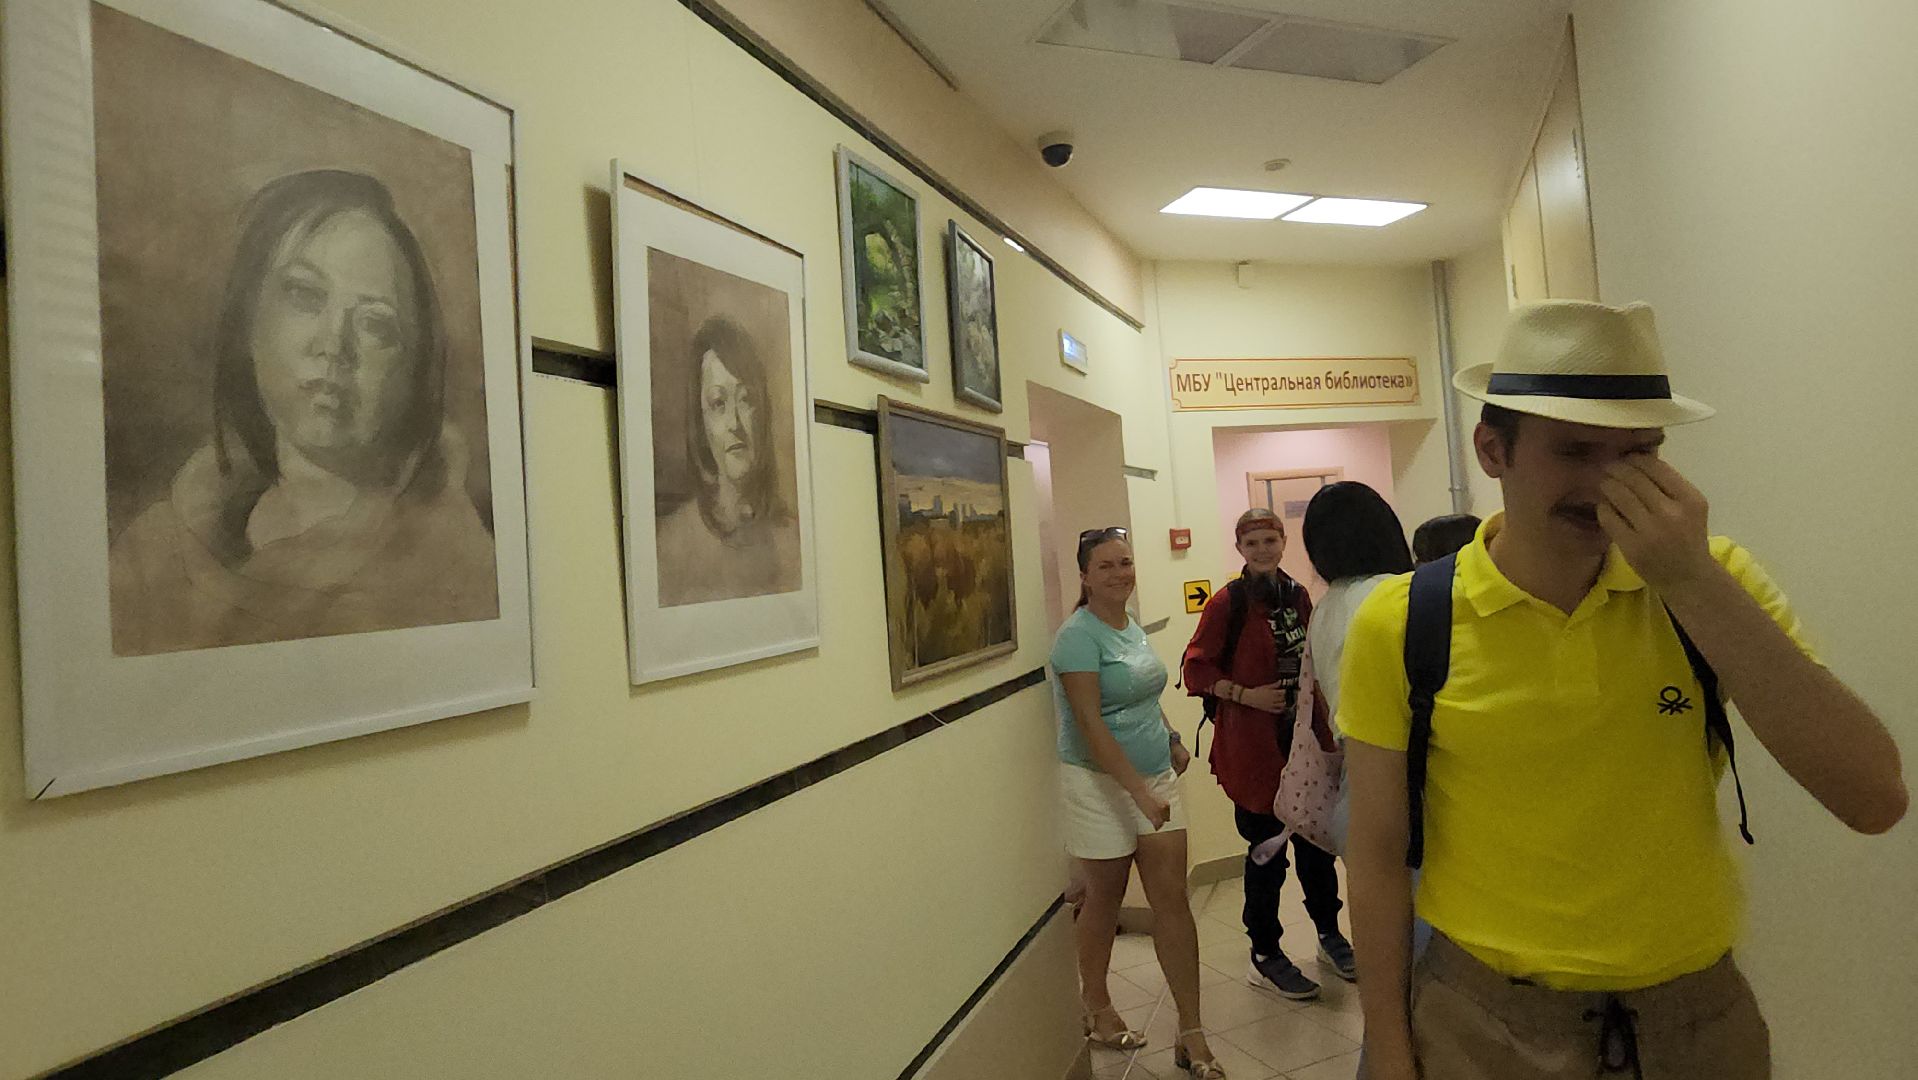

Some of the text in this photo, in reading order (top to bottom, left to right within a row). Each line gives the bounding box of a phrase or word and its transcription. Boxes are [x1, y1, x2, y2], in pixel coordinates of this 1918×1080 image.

[1176, 370, 1413, 396] МБУ "Центральная библиотека»
